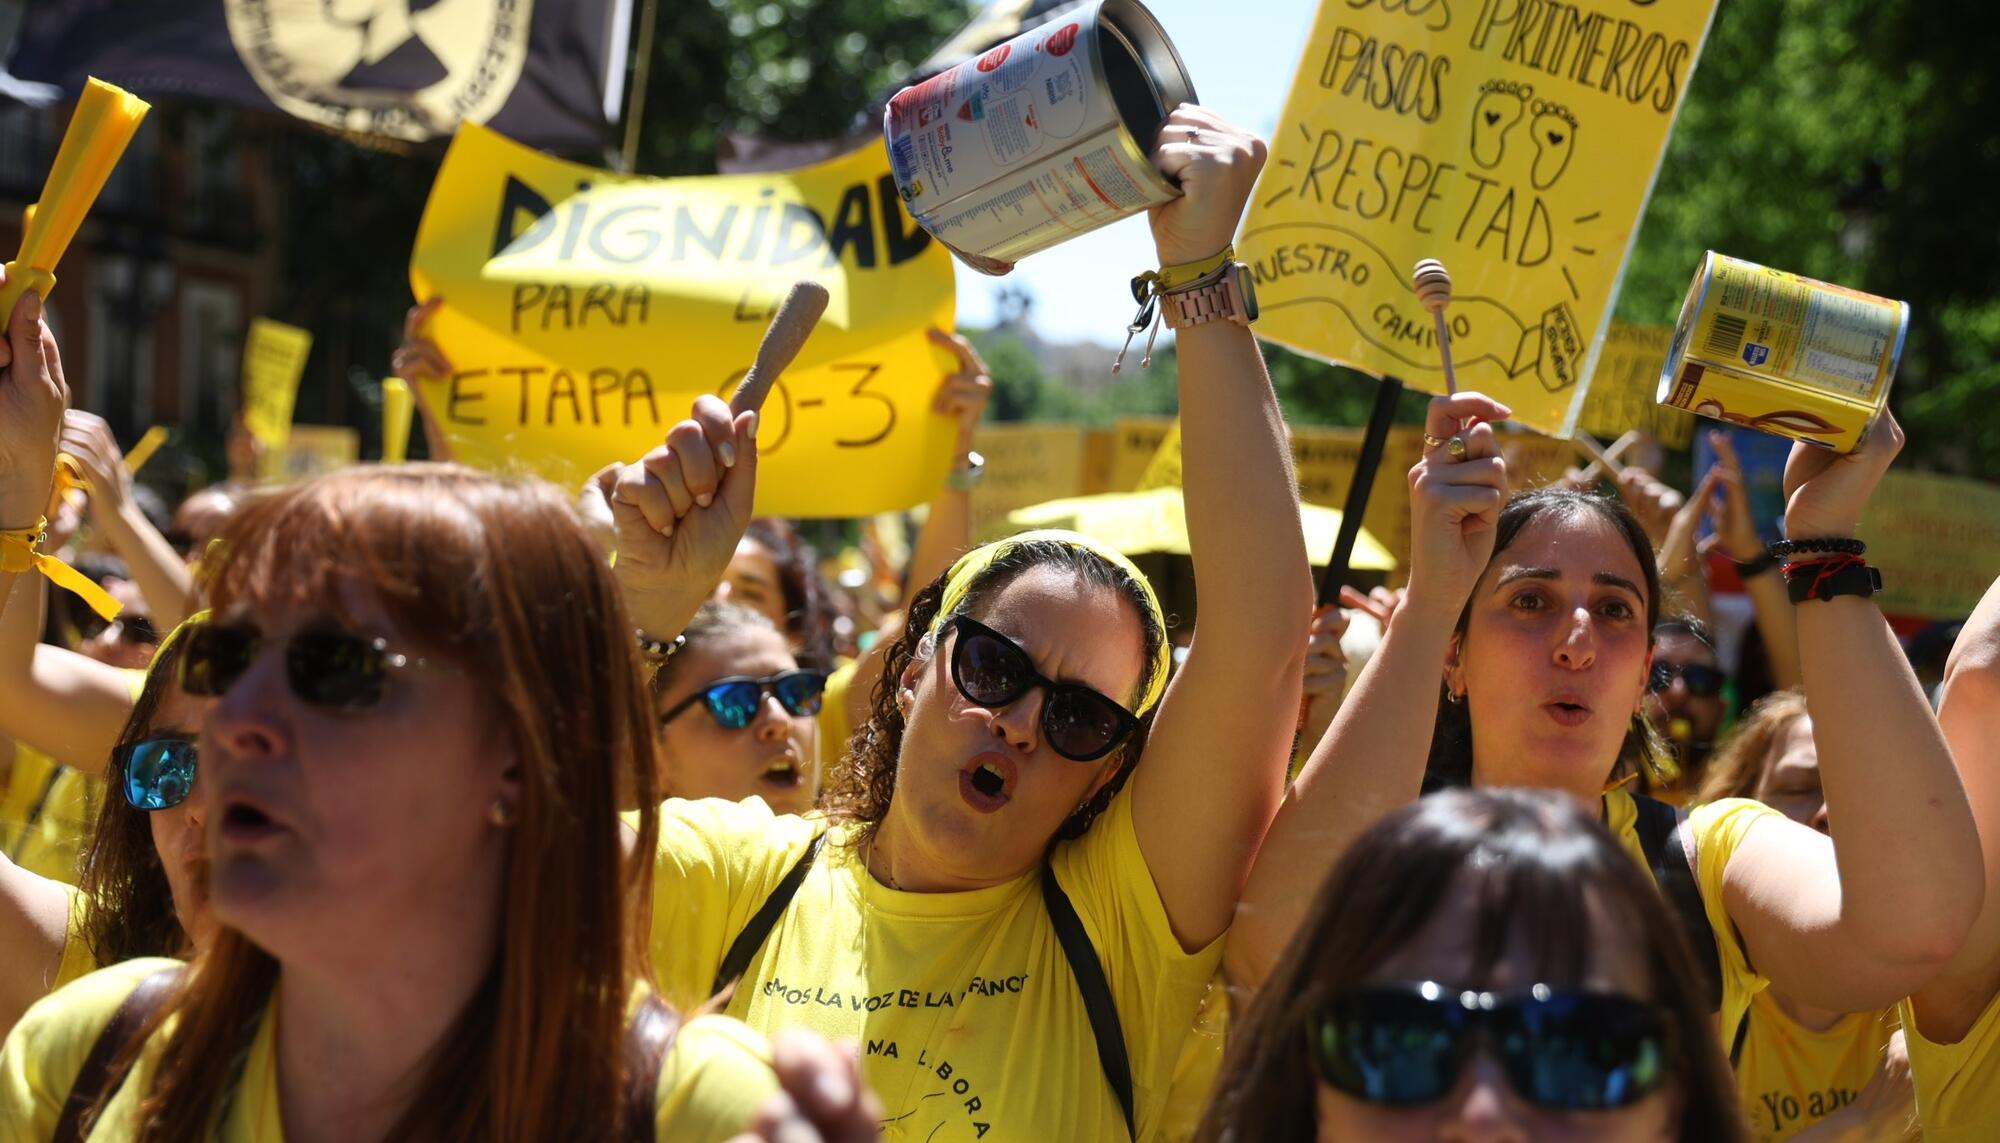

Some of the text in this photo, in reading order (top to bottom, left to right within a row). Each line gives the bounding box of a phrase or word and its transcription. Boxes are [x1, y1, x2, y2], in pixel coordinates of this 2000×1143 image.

[1319, 26, 1450, 124] PASOS
[1469, 0, 1689, 115] PRIMEROS
[1298, 129, 1553, 267] RESPETAD
[510, 281, 650, 334] PARA
[447, 366, 661, 427] ETAPA
[815, 987, 842, 1008] LA
[898, 989, 920, 1008] DE
[925, 991, 954, 1008] LA
[1760, 1089, 1799, 1132] Yo
